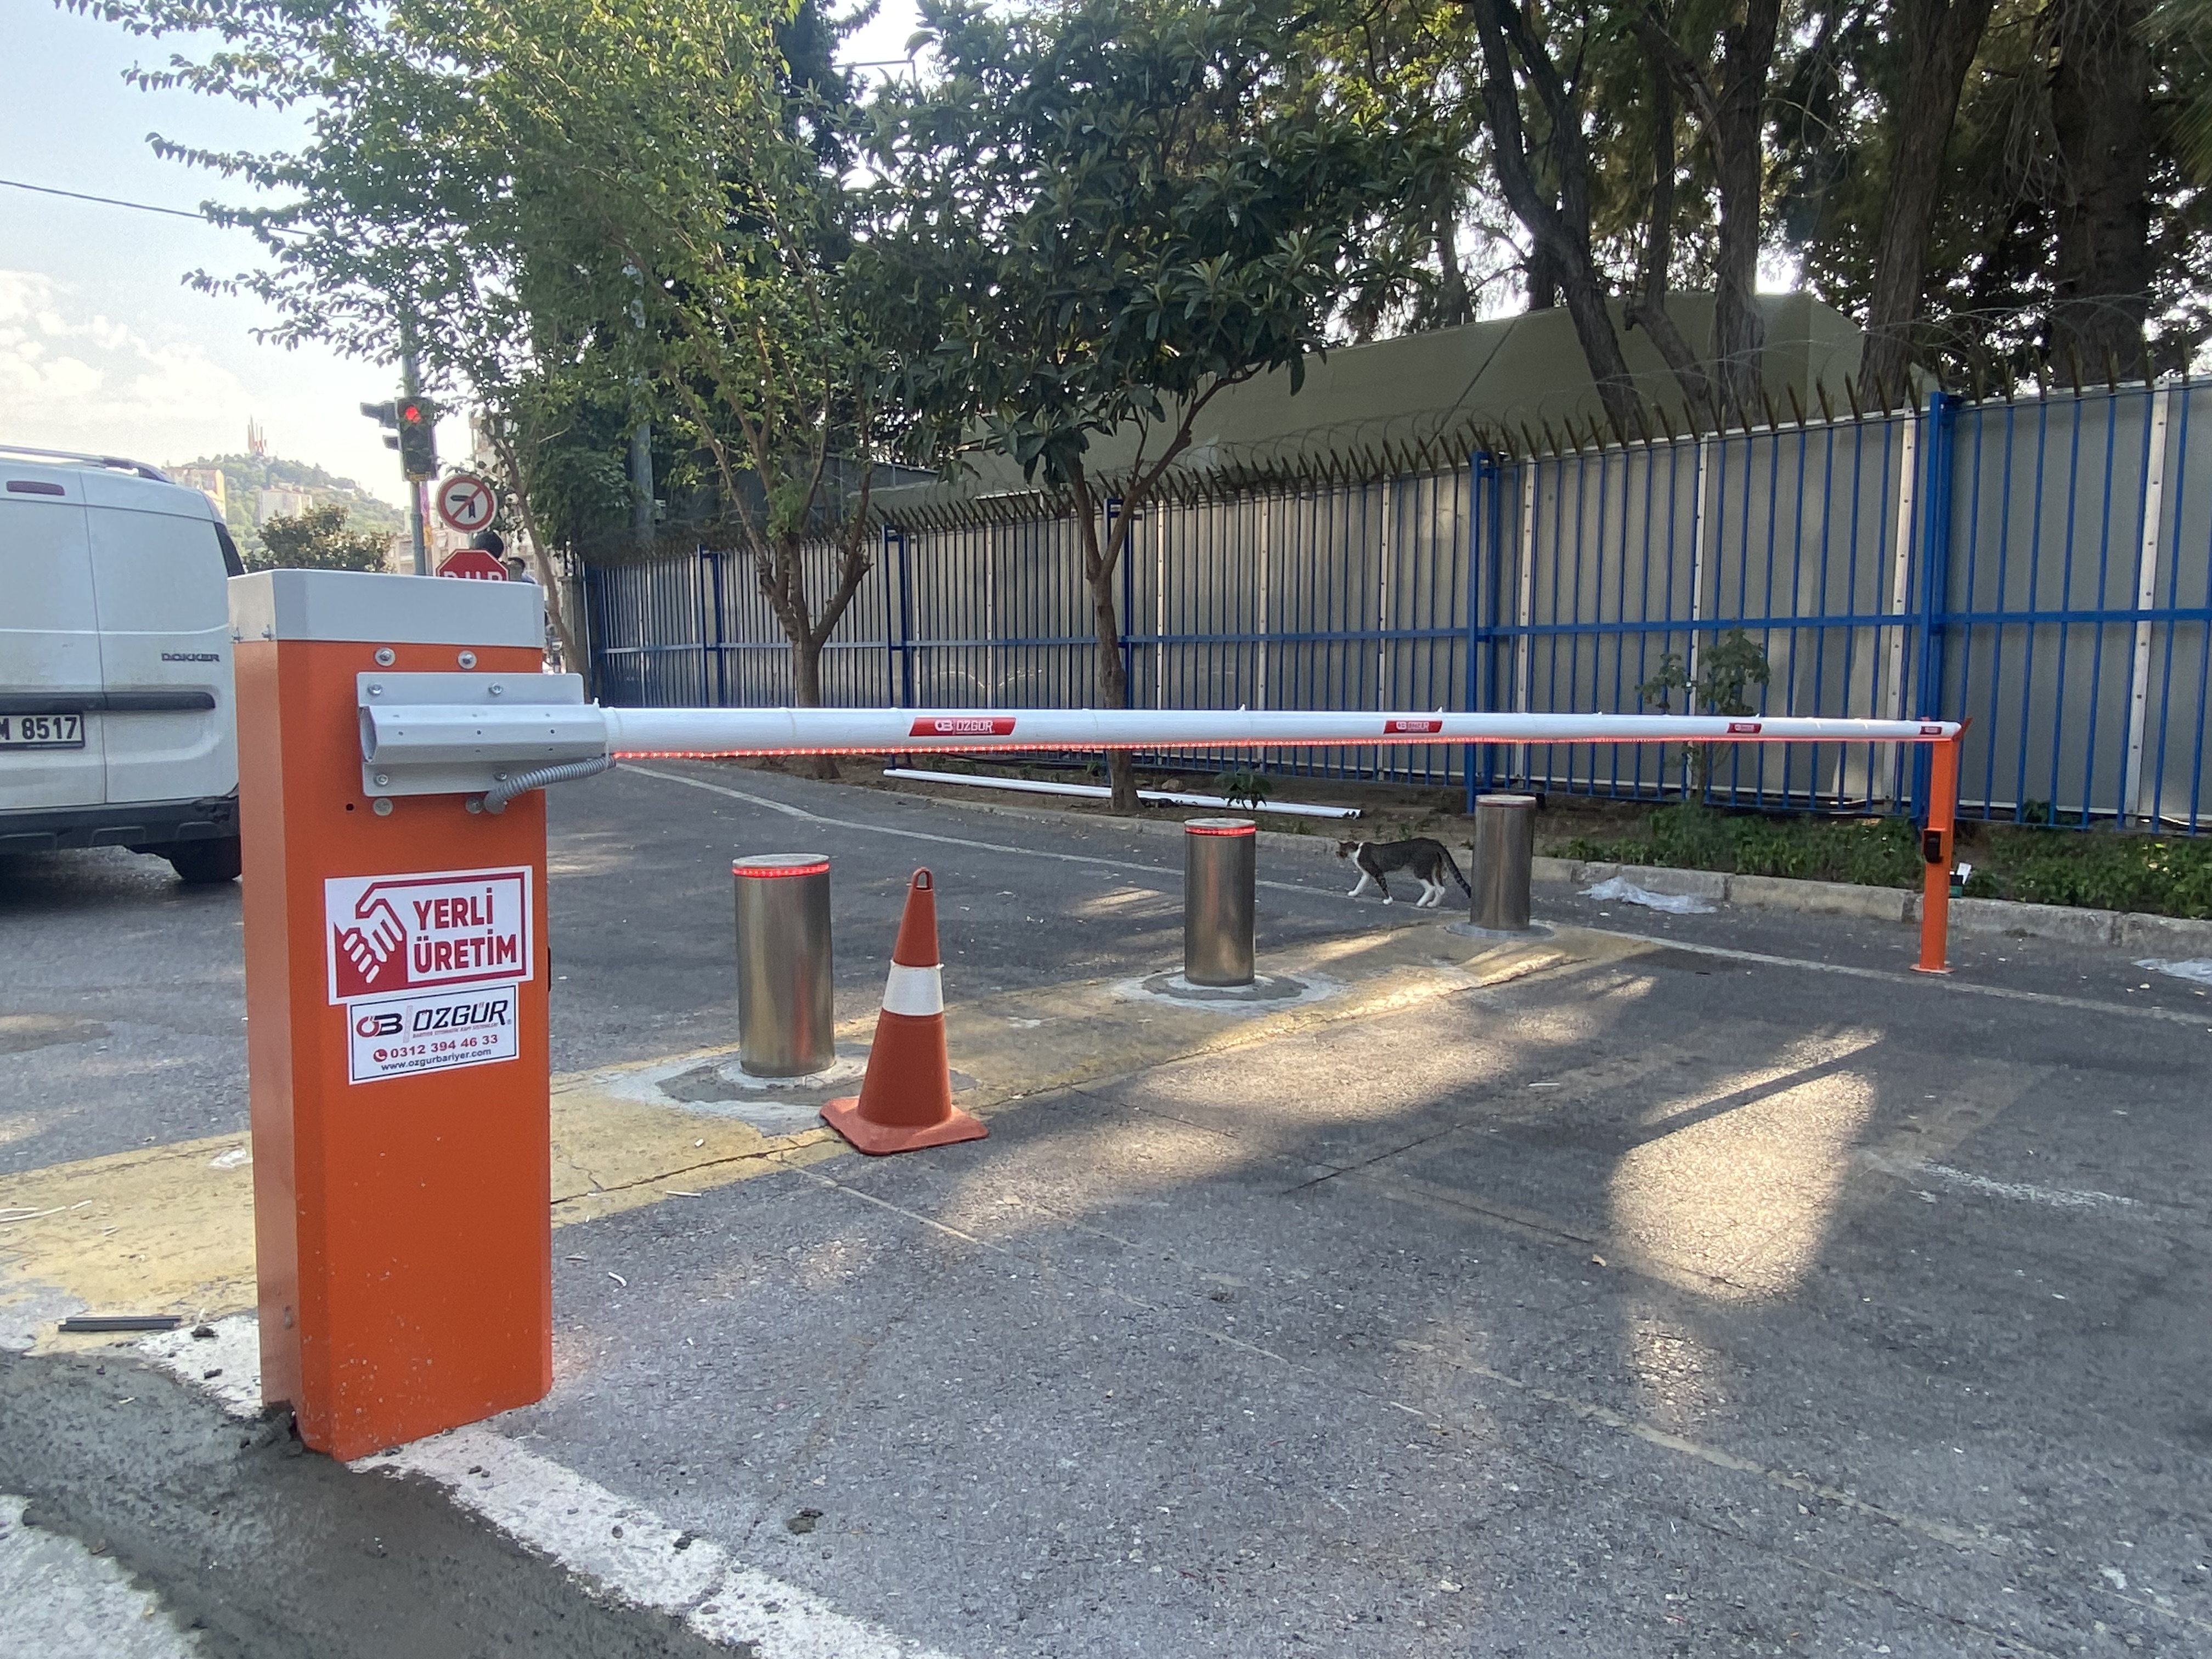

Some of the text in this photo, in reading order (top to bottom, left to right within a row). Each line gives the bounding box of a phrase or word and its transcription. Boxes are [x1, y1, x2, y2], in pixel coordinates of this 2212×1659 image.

[161, 653, 219, 662] DOKKER
[21, 717, 77, 740] 8517
[413, 887, 493, 930] YERLİ
[414, 928, 517, 974] ÜRETİM
[391, 1034, 498, 1058] 0312 394 46 33
[381, 1048, 492, 1071] www.ozgurbariyer.com
